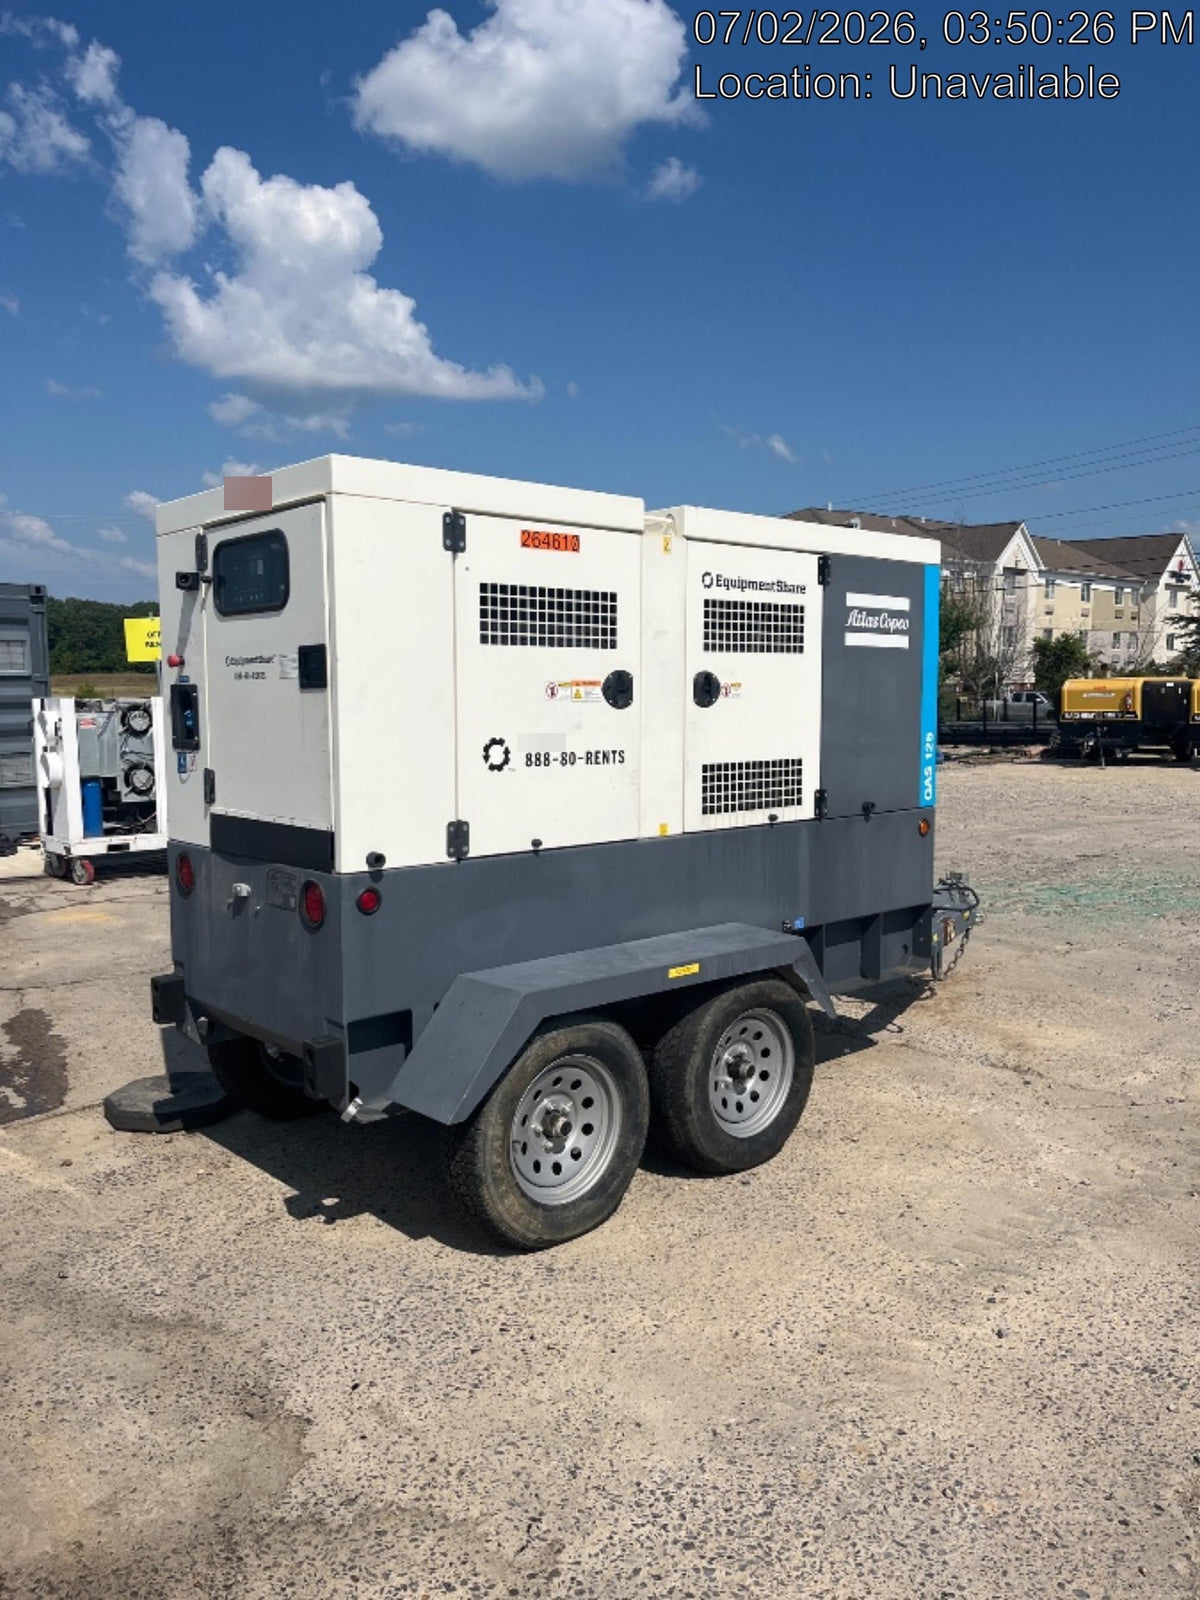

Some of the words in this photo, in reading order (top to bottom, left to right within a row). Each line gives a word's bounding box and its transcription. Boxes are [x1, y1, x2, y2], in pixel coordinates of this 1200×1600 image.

[715, 574, 807, 595] EquipmentShare
[845, 609, 879, 628] Atlas
[525, 750, 625, 767] 888-80-RENTS
